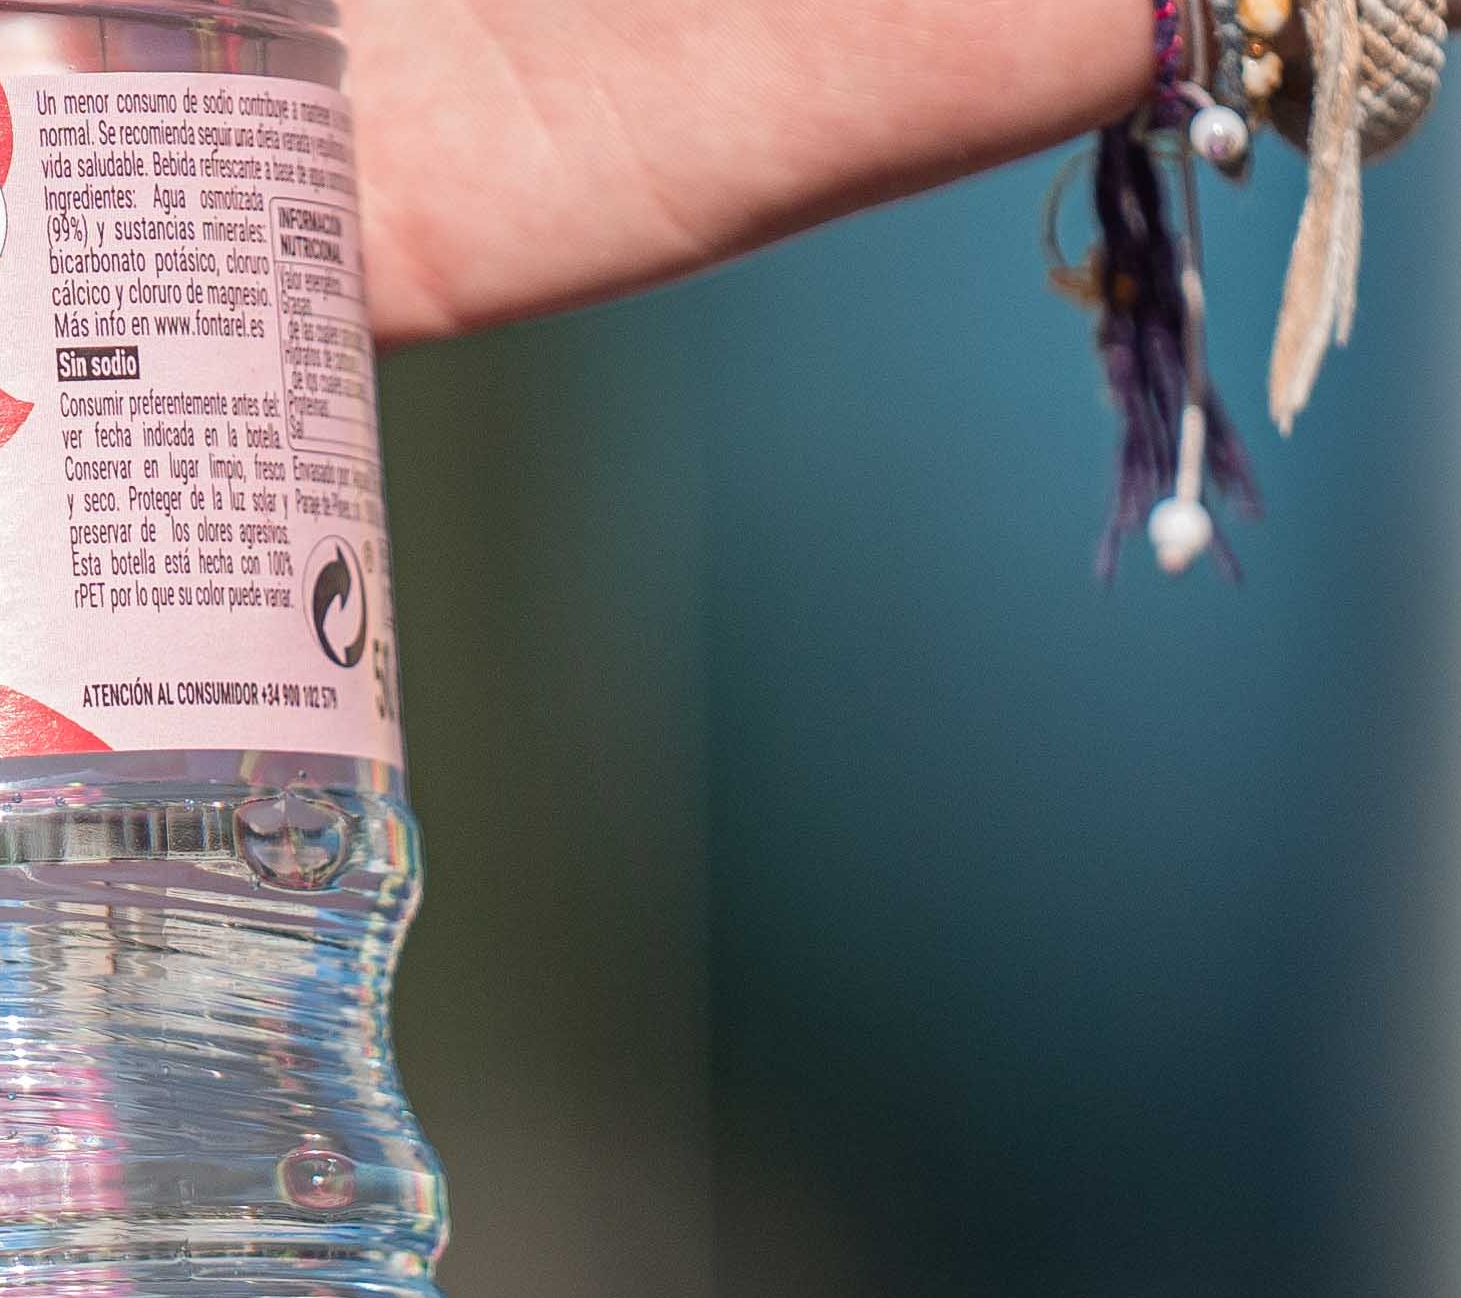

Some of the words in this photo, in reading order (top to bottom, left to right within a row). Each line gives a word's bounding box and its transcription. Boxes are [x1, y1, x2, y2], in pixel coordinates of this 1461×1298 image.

[36, 90, 57, 115] Un
[64, 93, 110, 114] menor
[117, 92, 177, 114] consumo
[183, 87, 198, 114] de
[203, 89, 233, 115] sodio
[40, 120, 94, 147] normal.
[98, 120, 116, 146] Se
[120, 120, 196, 146] recomienda
[198, 122, 232, 153] seguir
[234, 128, 254, 148] una
[42, 153, 72, 178] vida
[77, 151, 148, 179] saludable.
[153, 151, 197, 177] Bebida
[200, 149, 262, 180] refrescante
[44, 184, 136, 215] Ingredientes:
[153, 183, 186, 215] Agua
[200, 184, 264, 212] osmotizada
[47, 214, 88, 248] (99%)
[96, 222, 105, 247] y
[115, 218, 195, 242] sustancias
[203, 216, 267, 243] minerales:
[49, 248, 145, 275] bicarbonato
[156, 246, 220, 278] potásico,
[227, 252, 270, 275] cloruro
[52, 278, 110, 306] cálcico
[116, 288, 128, 311] y
[129, 278, 180, 304] cloruro
[186, 278, 203, 304] de
[207, 283, 272, 311] magnesio.
[54, 310, 89, 338] Más
[95, 312, 126, 337] info
[132, 318, 150, 336] en
[156, 310, 264, 338] www.fontarel.es
[58, 349, 89, 378] Sin
[91, 349, 137, 378] sodio
[60, 392, 123, 417] Consumir
[130, 389, 228, 422] preferentemente
[232, 394, 260, 417] antes
[62, 427, 82, 449] ver
[95, 422, 131, 447] fecha
[142, 421, 195, 447] indicada
[204, 427, 218, 447] en
[228, 421, 238, 446] la
[246, 422, 283, 449] botella.
[65, 455, 132, 481] Conservar
[144, 459, 159, 479] en
[169, 452, 199, 485] lugar
[209, 452, 246, 486] limpio,
[254, 453, 285, 481] fresco
[67, 495, 74, 520] y
[84, 492, 120, 513] seco.
[129, 486, 182, 517] Proteger
[190, 485, 204, 510] de
[212, 485, 223, 510] la
[228, 485, 246, 511] luz
[252, 488, 277, 512] solar
[282, 493, 288, 519] y
[70, 523, 131, 554] preservar
[141, 518, 156, 542] de
[171, 516, 190, 542] los
[198, 517, 232, 543] olores
[240, 520, 291, 549] agresivos.
[72, 551, 101, 576] Esta
[111, 549, 155, 575] botella
[165, 548, 190, 574] está
[199, 551, 234, 575] hecha
[241, 555, 260, 574] con
[267, 551, 293, 576] 100%
[74, 582, 105, 608] rPET
[110, 586, 131, 613] por
[136, 581, 148, 606] lo
[152, 586, 175, 612] que
[179, 586, 192, 606] su
[196, 579, 225, 606] color
[229, 581, 261, 610] puede
[264, 584, 294, 608] variar.
[83, 677, 153, 708] ATENCIÓN
[158, 681, 174, 705] AL
[177, 681, 258, 706] CONSUMIDOR
[262, 683, 280, 706] +34
